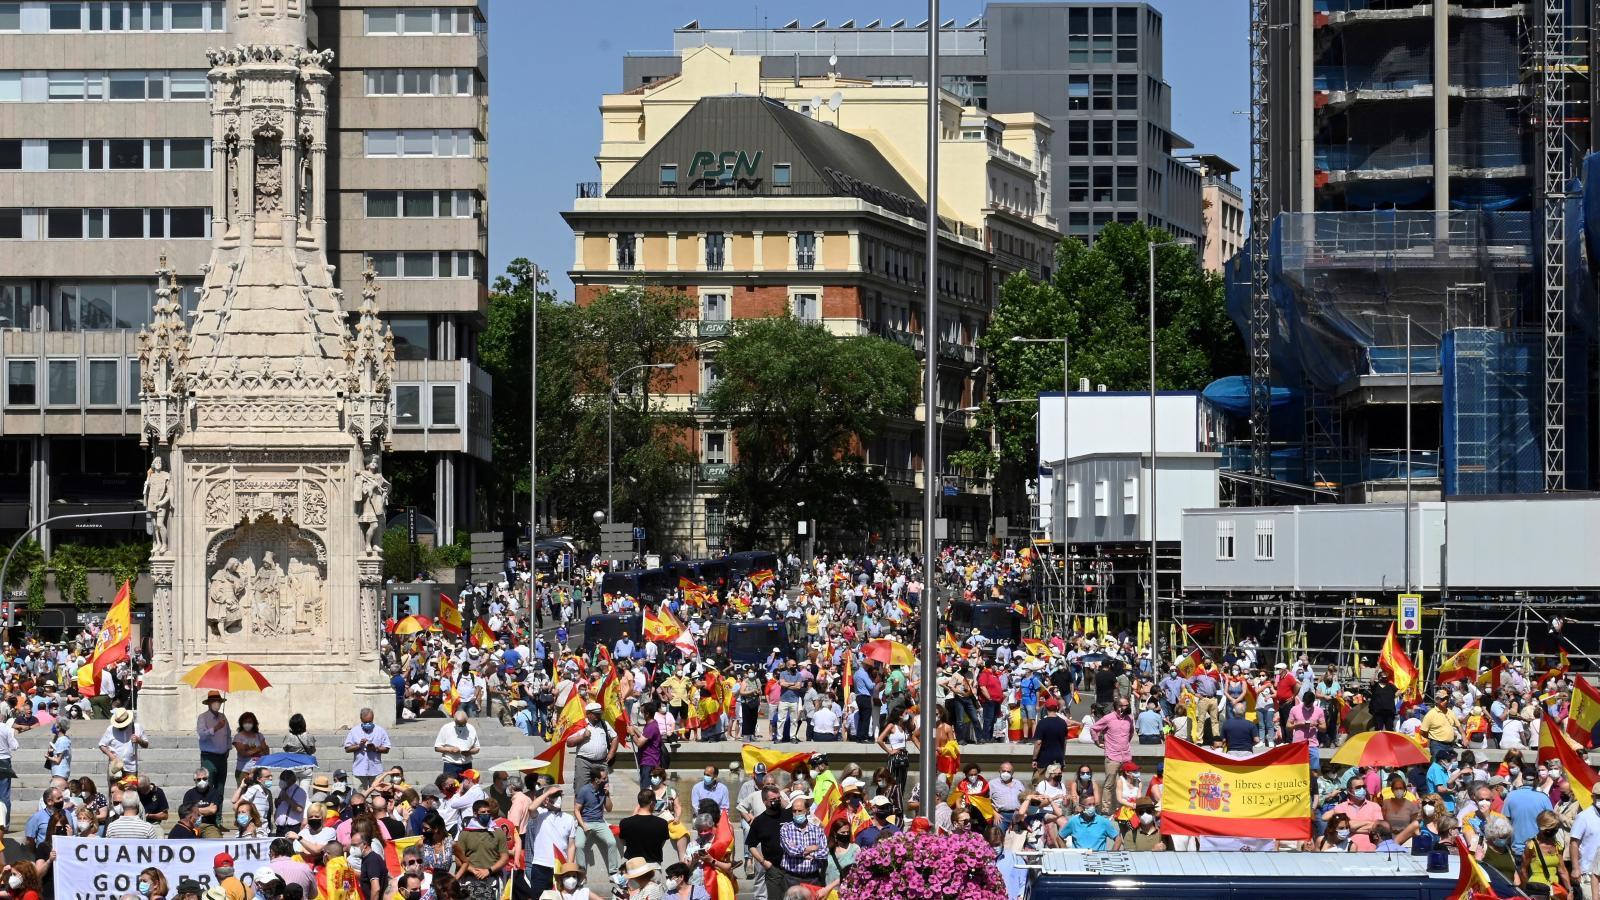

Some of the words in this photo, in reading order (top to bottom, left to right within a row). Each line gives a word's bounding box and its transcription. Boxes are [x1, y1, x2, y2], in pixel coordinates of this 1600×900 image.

[687, 150, 763, 178] PSN
[706, 324, 724, 332] PSN
[1234, 779, 1262, 789] libres
[1273, 778, 1308, 791] iguales
[1241, 794, 1265, 805] 1812
[1268, 797, 1274, 807] y
[1279, 793, 1301, 804] 1978
[75, 844, 195, 863] CUANDO
[224, 842, 261, 861] UN
